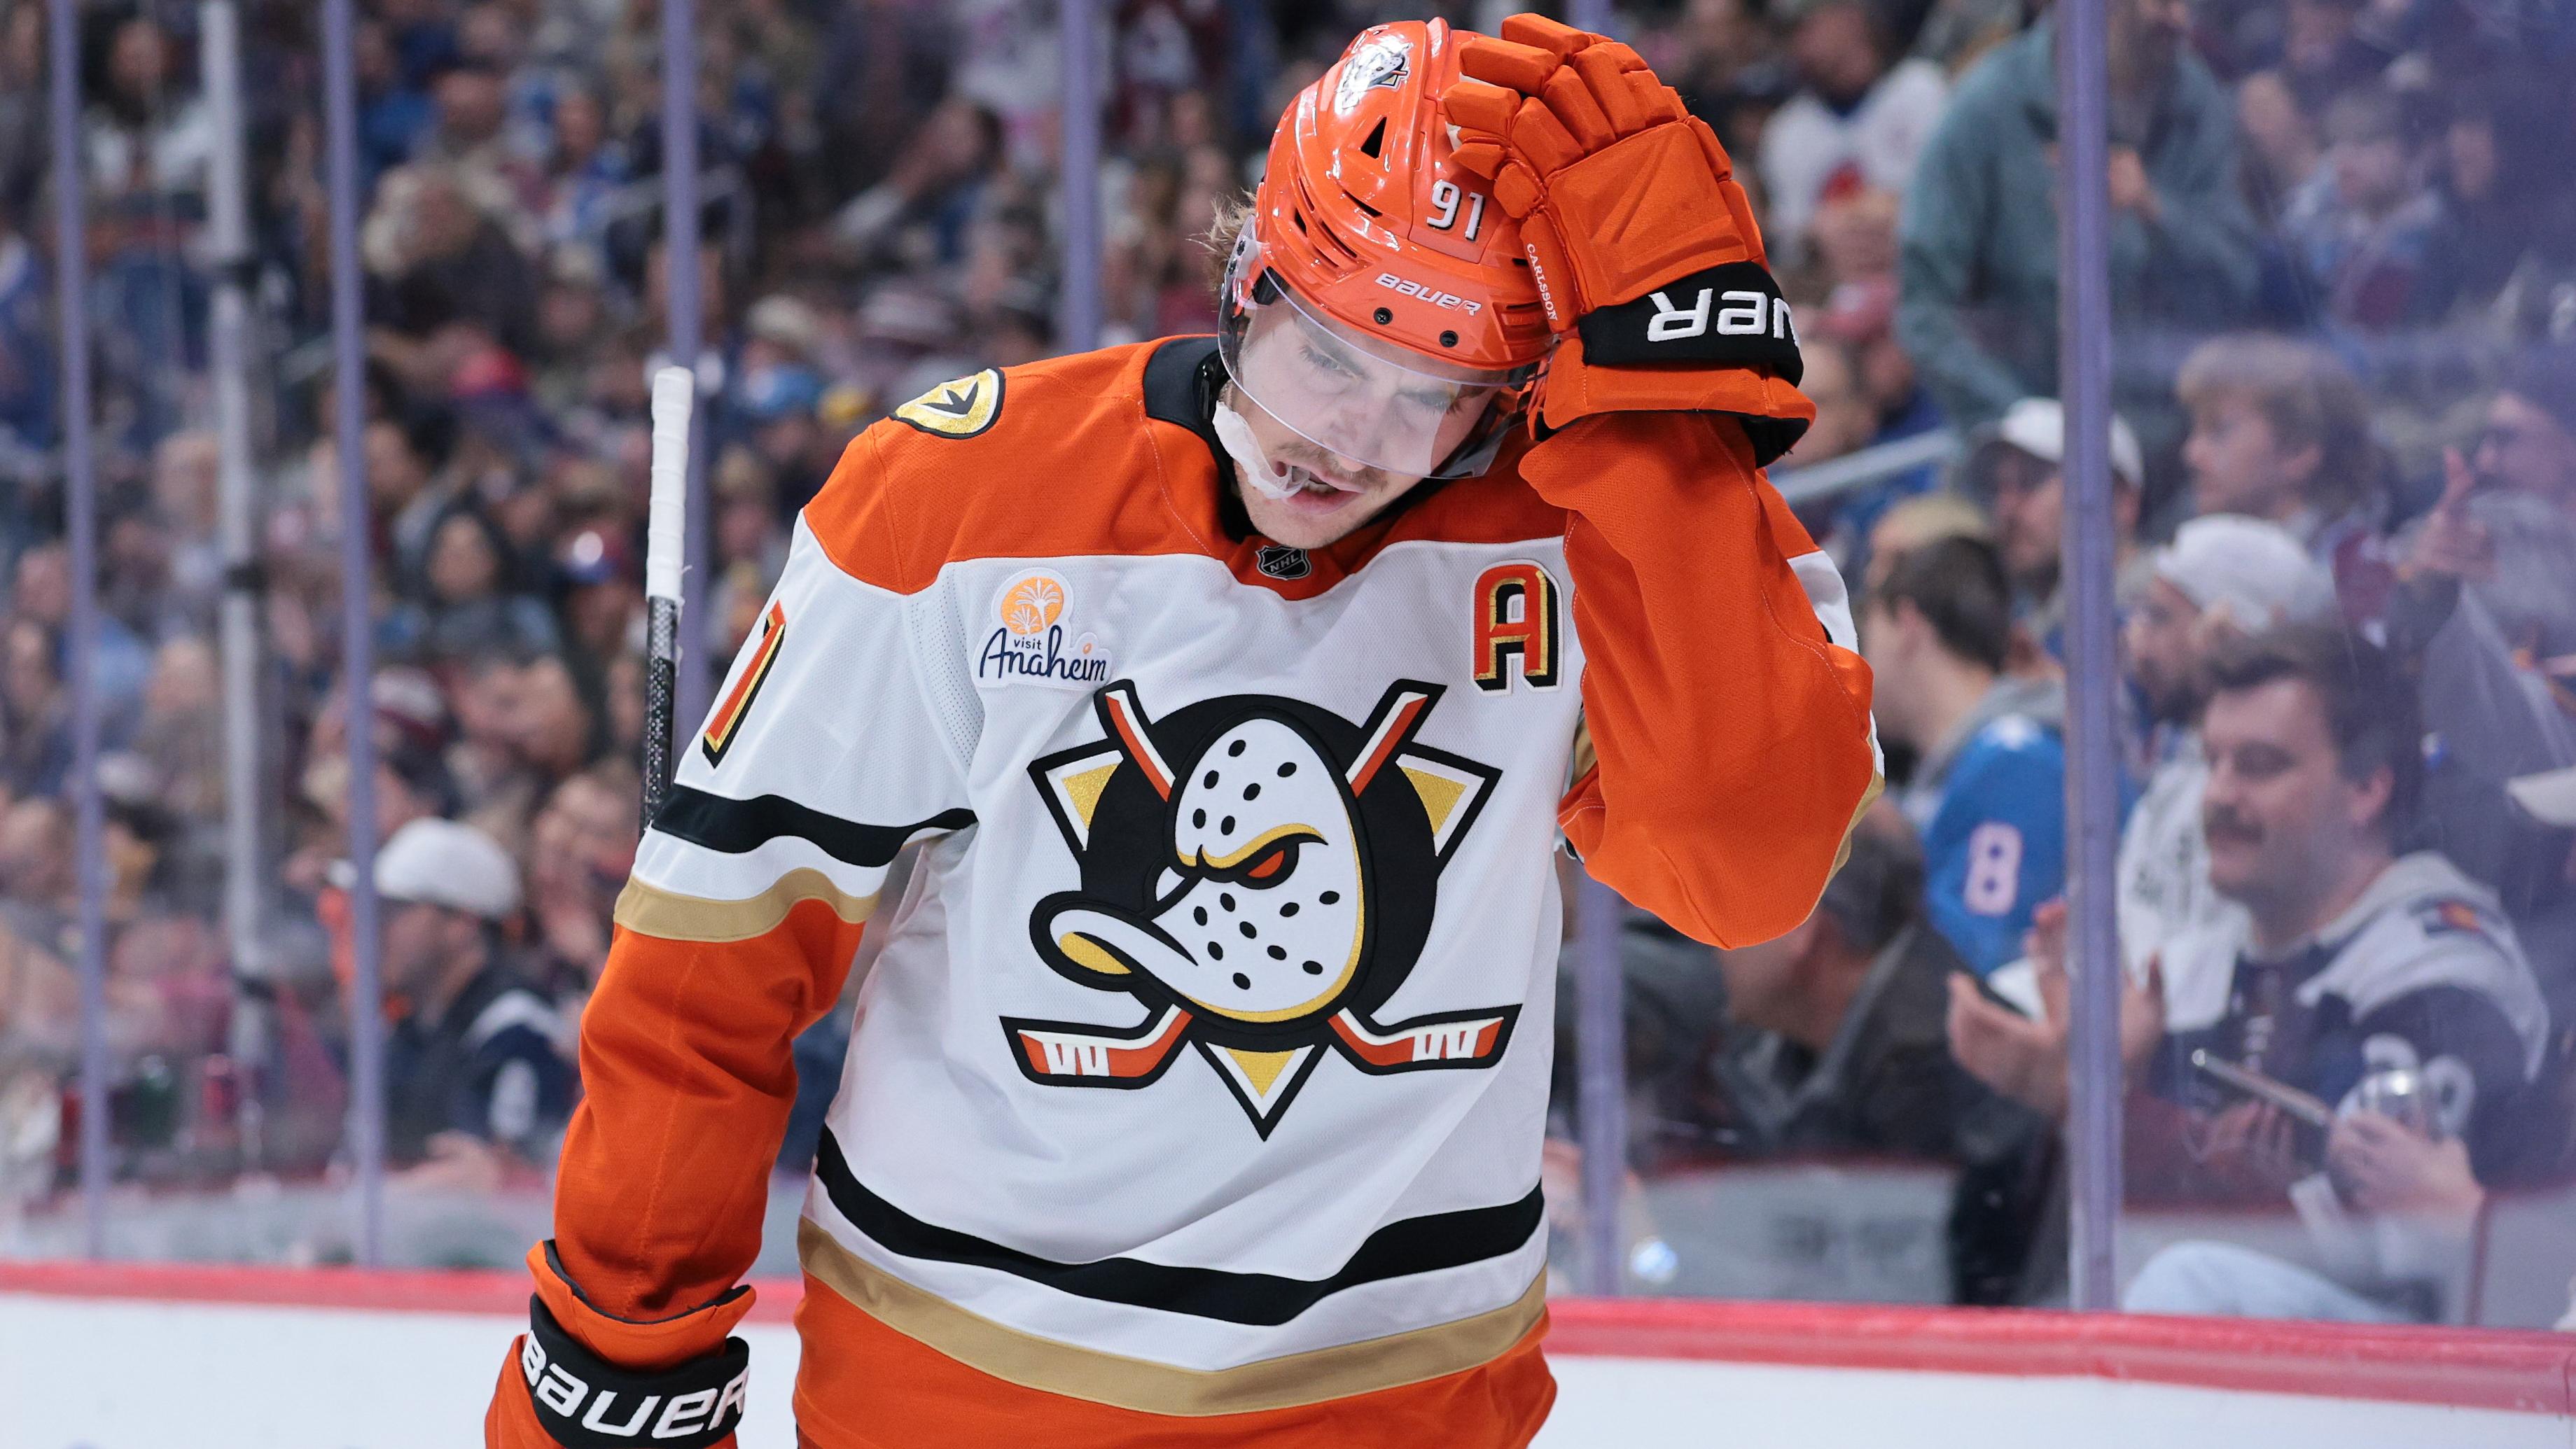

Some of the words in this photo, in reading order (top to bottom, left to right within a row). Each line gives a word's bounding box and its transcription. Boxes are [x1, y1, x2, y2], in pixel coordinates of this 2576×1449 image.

[1426, 178, 1487, 241] 91
[1374, 272, 1482, 316] BAUER
[1526, 243, 1558, 321] CARLSSON
[1269, 554, 1300, 573] NHL
[979, 624, 1107, 682] Anaheim
[1014, 636, 1042, 650] visit
[1473, 563, 1559, 692] A
[1963, 821, 2023, 918] 8
